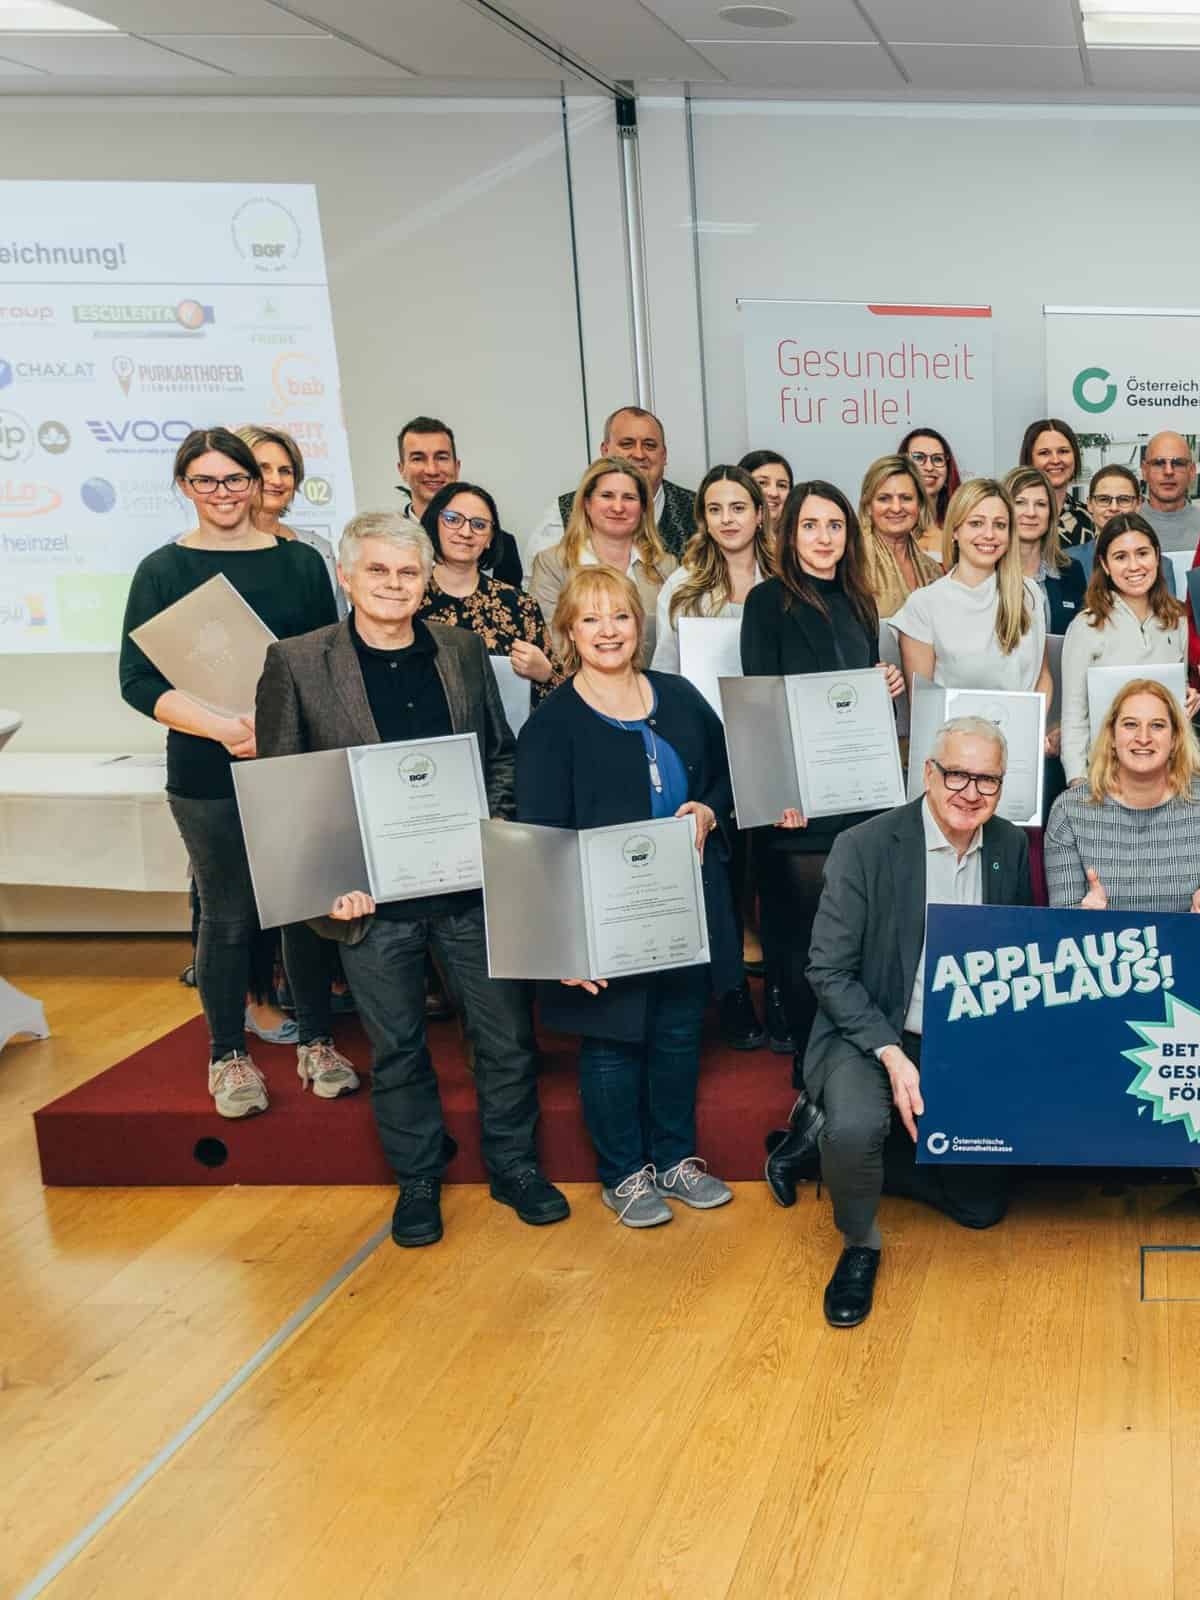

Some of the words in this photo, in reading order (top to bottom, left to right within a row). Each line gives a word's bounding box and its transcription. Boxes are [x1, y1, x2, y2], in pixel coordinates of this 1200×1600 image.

[778, 339, 975, 379] Gesundheit
[779, 386, 829, 425] für
[841, 388, 911, 425] alle!
[931, 925, 1160, 992] APPLAUS!
[947, 954, 1175, 1022] APPLAUS!
